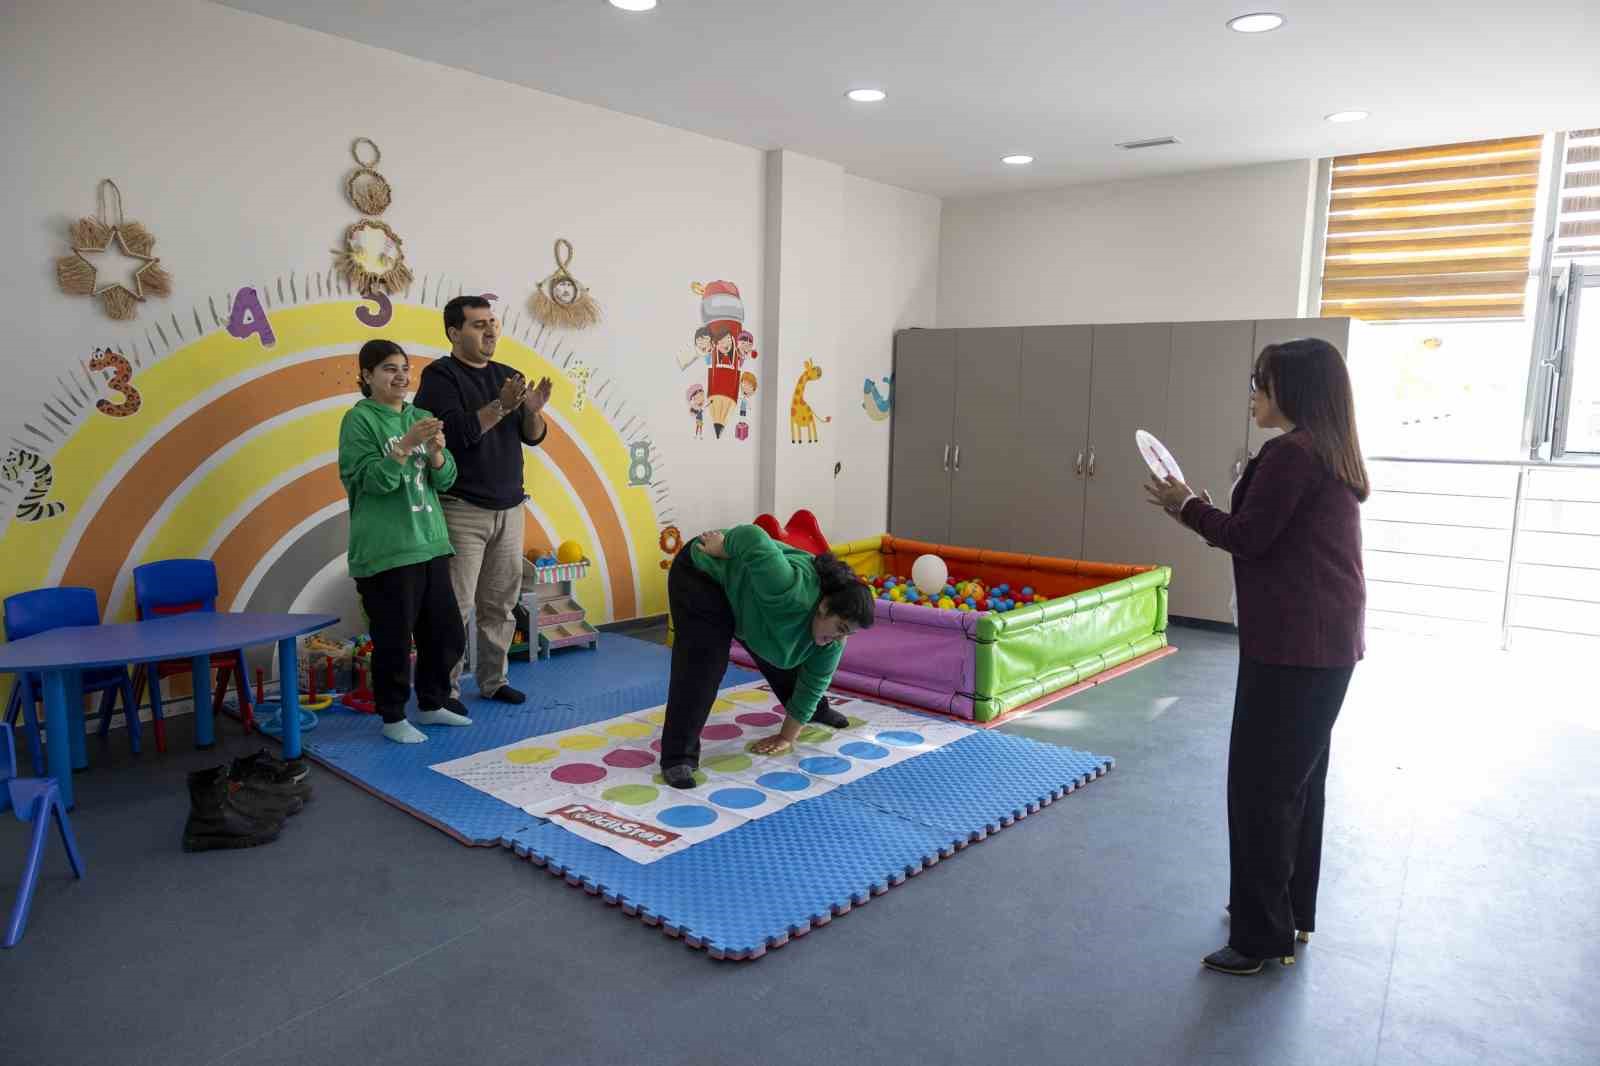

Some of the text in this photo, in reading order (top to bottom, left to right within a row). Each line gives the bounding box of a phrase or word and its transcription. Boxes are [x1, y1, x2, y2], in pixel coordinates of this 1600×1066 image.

[228, 287, 275, 345] 4
[89, 348, 141, 417] 3
[2, 449, 65, 521] 2
[628, 441, 652, 486] 8
